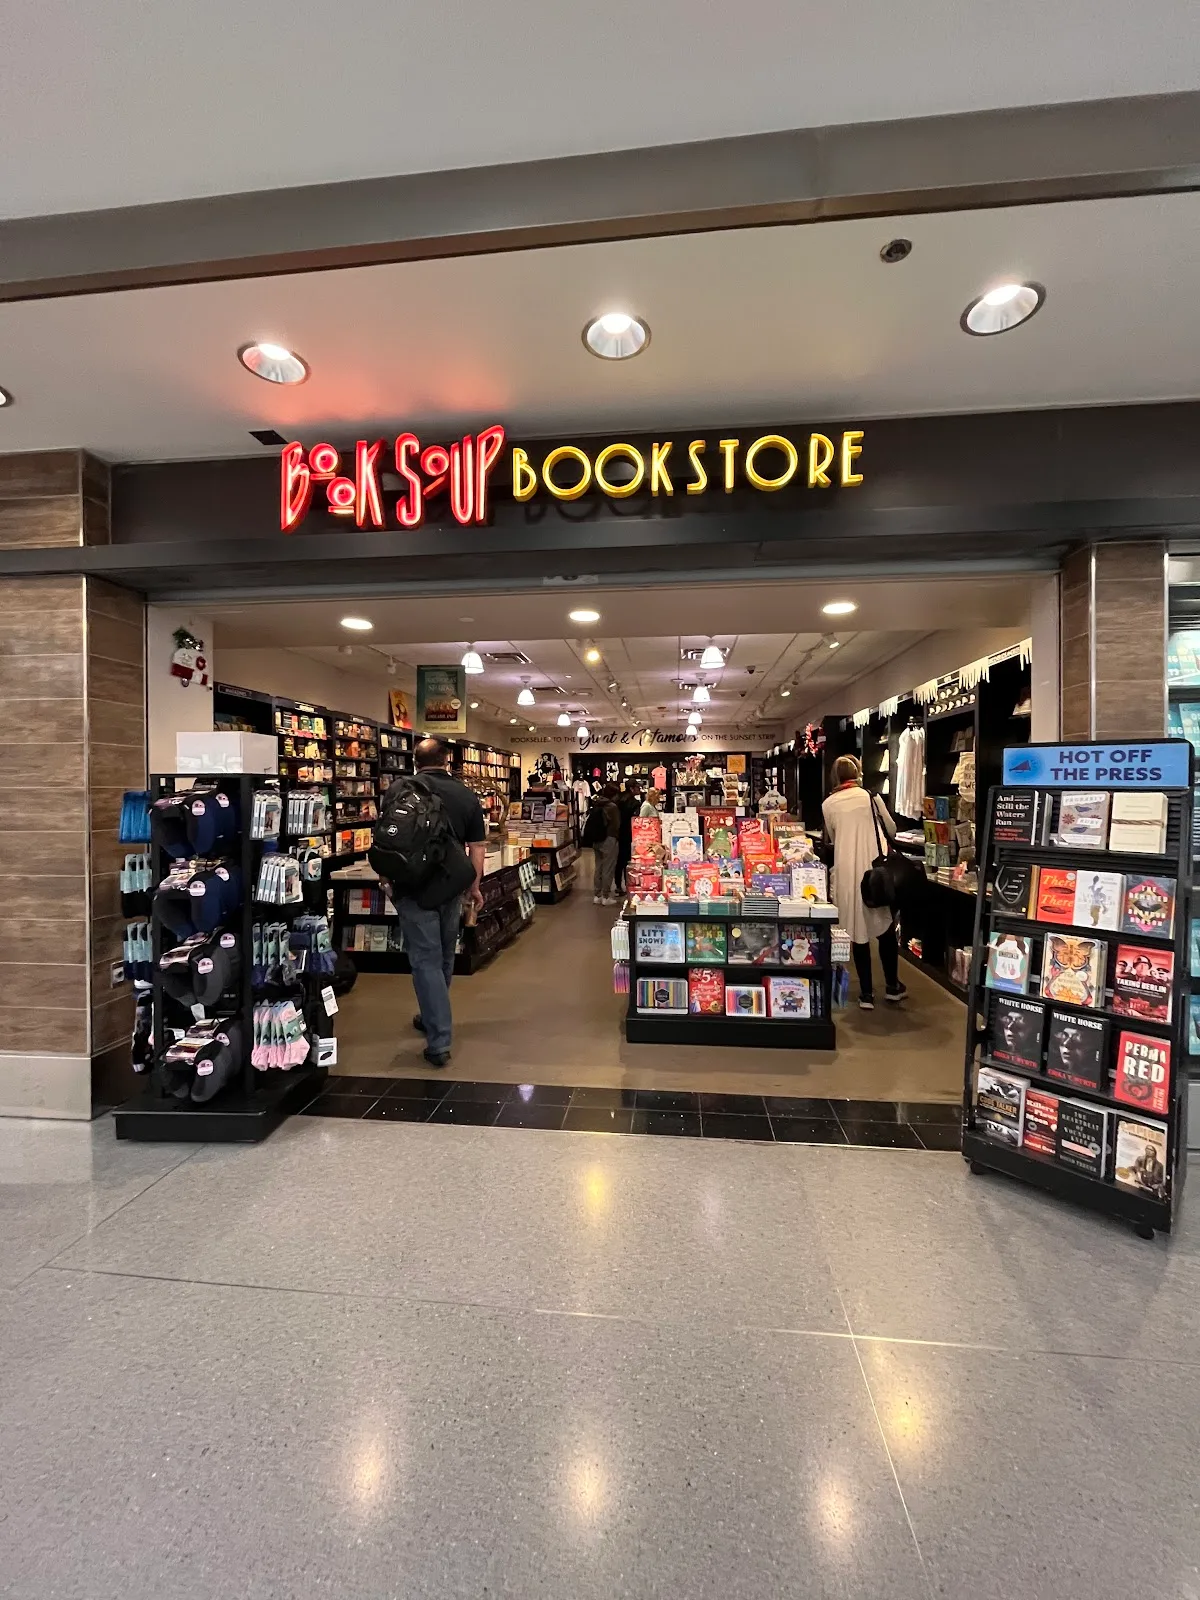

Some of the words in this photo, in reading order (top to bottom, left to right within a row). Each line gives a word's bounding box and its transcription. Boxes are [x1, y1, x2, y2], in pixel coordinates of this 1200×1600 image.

[512, 430, 865, 500] BOOKSTORE
[280, 438, 385, 534] BOOK
[396, 424, 506, 529] SOUP
[621, 731, 630, 745] &
[631, 728, 698, 746] Ifamous
[1059, 749, 1104, 764] HOT
[1110, 749, 1153, 763] OFF
[1050, 767, 1090, 781] THE
[1096, 767, 1162, 781] PRESS
[996, 802, 1014, 810] Still
[996, 810, 1026, 818] Waters
[1043, 875, 1076, 888] There
[1040, 894, 1074, 907] There
[641, 929, 679, 937] LITT
[702, 969, 712, 983] 5
[1116, 977, 1141, 989] TAKING
[1141, 982, 1167, 994] BERLIN
[998, 997, 1020, 1009] WHITE
[1021, 1002, 1043, 1014] HORSE
[1053, 1011, 1076, 1024] WHITE
[1077, 1017, 1103, 1031] HORSE
[1124, 1040, 1167, 1065] PERMA
[1122, 1055, 1165, 1083] RED
